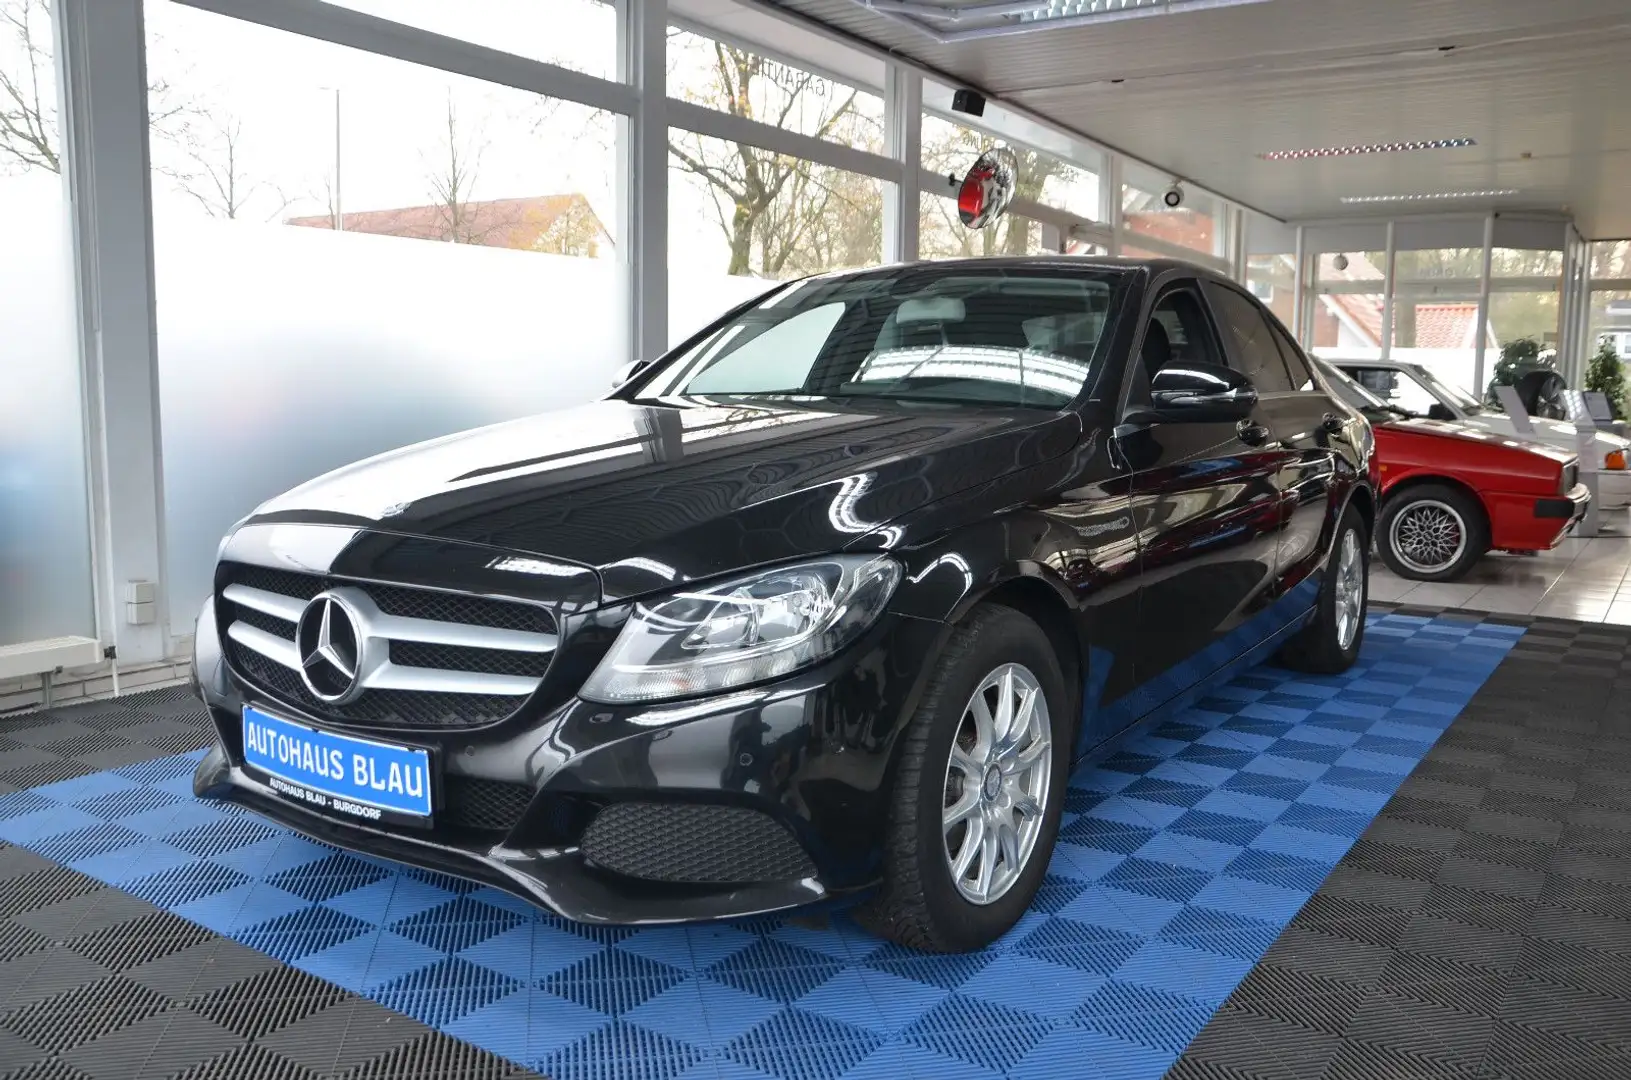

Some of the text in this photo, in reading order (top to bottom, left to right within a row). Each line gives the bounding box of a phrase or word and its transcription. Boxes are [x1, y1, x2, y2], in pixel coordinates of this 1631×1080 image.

[248, 721, 423, 798] AUTOHAUS BLAU
[269, 777, 305, 799] AUTOHAUS
[306, 790, 326, 806] BLAU
[333, 798, 382, 820] BURGDORF
